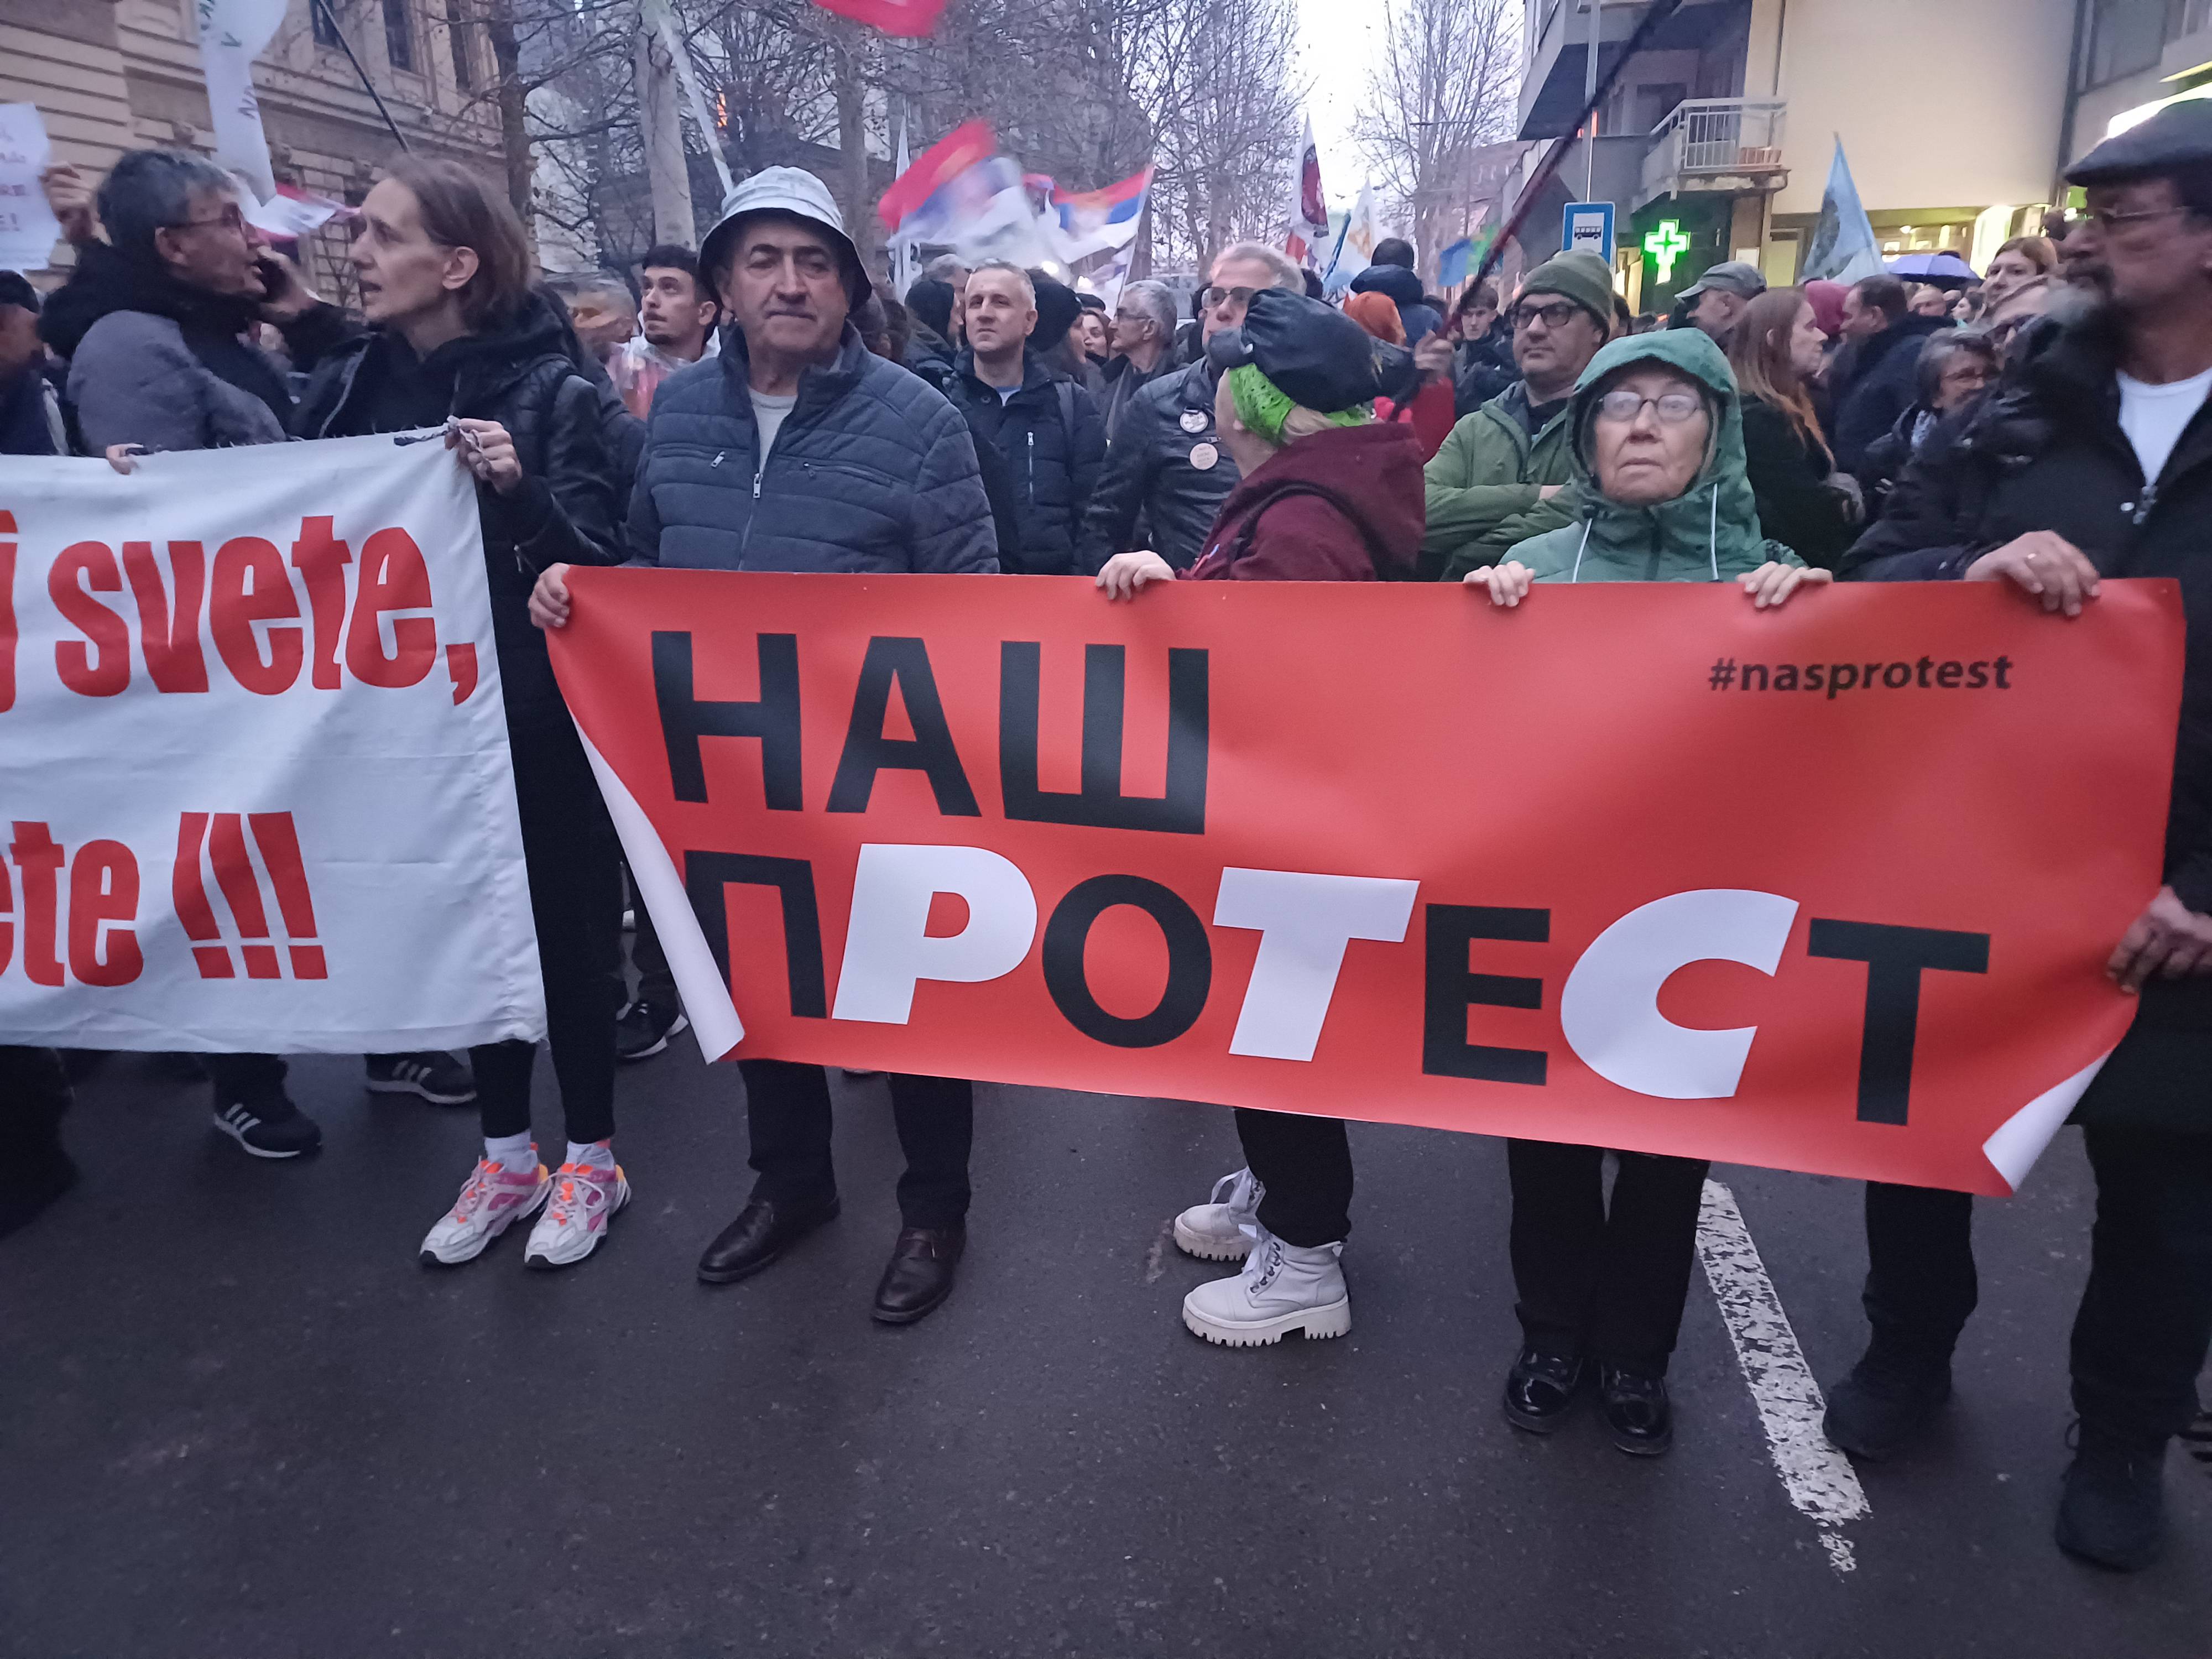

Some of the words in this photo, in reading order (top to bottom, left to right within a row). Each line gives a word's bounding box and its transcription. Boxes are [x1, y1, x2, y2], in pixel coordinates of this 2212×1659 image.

[48, 515, 478, 706] svete,
[1709, 655, 2013, 700] #nasprotest
[651, 630, 1209, 835] НАШ
[0, 821, 143, 987] te
[173, 811, 328, 979] !!!
[684, 843, 1990, 1126] ПРОТЕСТ
